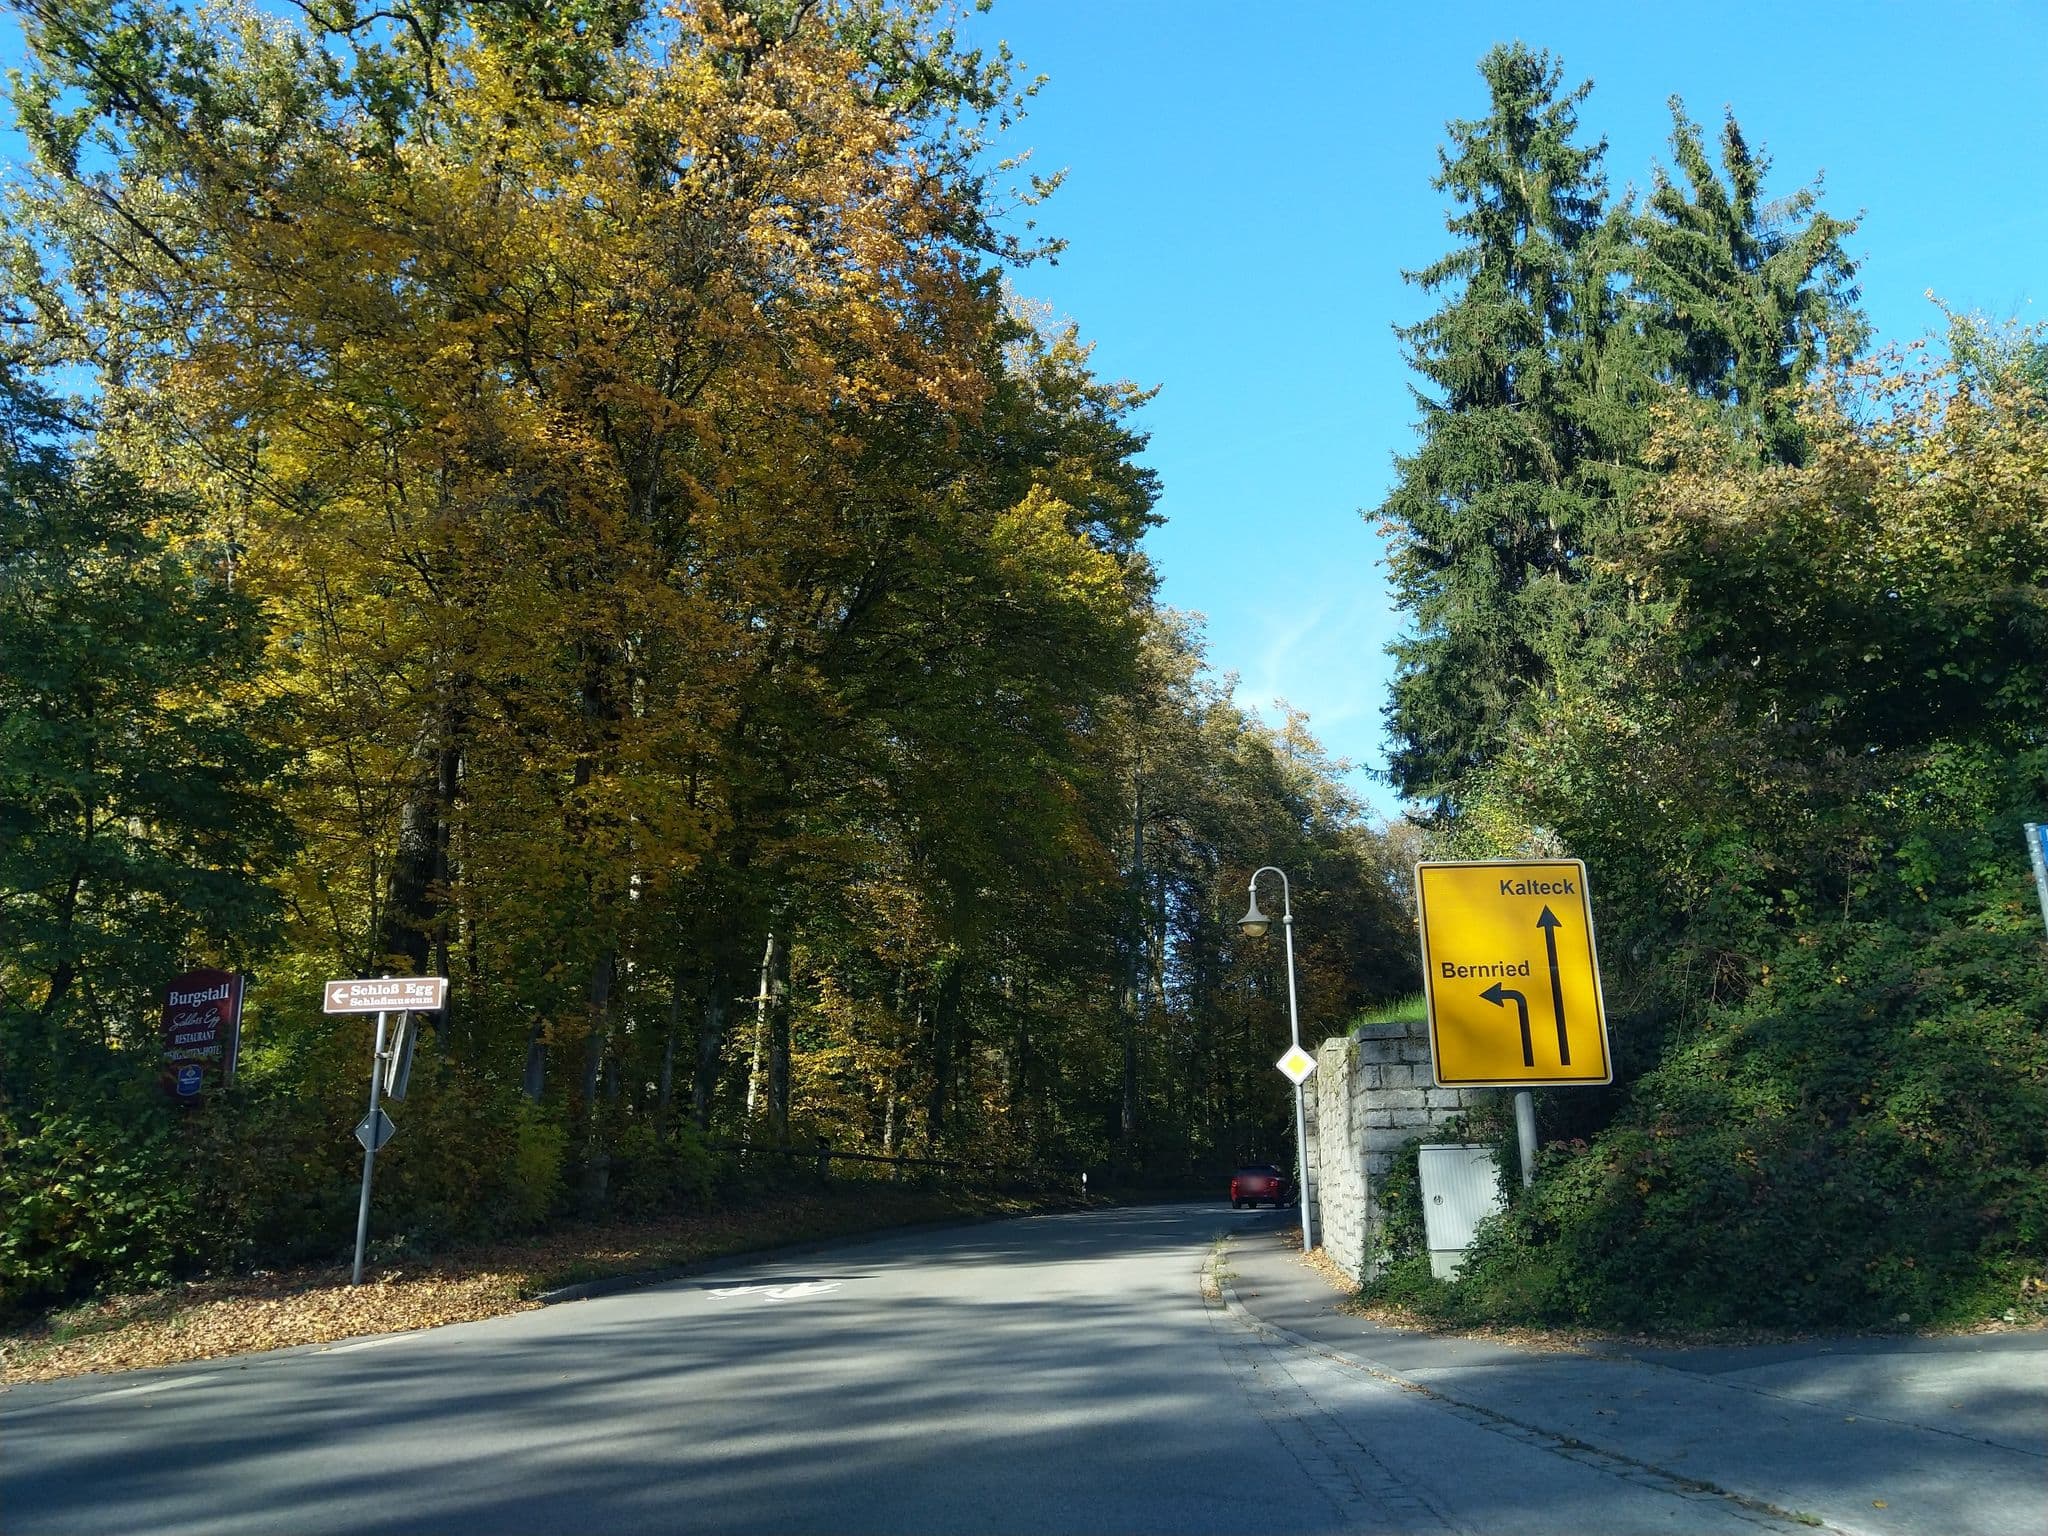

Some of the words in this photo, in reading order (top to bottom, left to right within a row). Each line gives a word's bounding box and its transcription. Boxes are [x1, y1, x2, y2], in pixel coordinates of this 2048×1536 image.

[1500, 879, 1575, 896] Kalteck
[1442, 960, 1530, 979] Bernried
[170, 983, 229, 1007] Burgstall
[350, 984, 400, 996] Schloß
[405, 982, 434, 996] Egg
[350, 996, 433, 1007] Schloßmuseum
[175, 1030, 216, 1045] RESTAURANT
